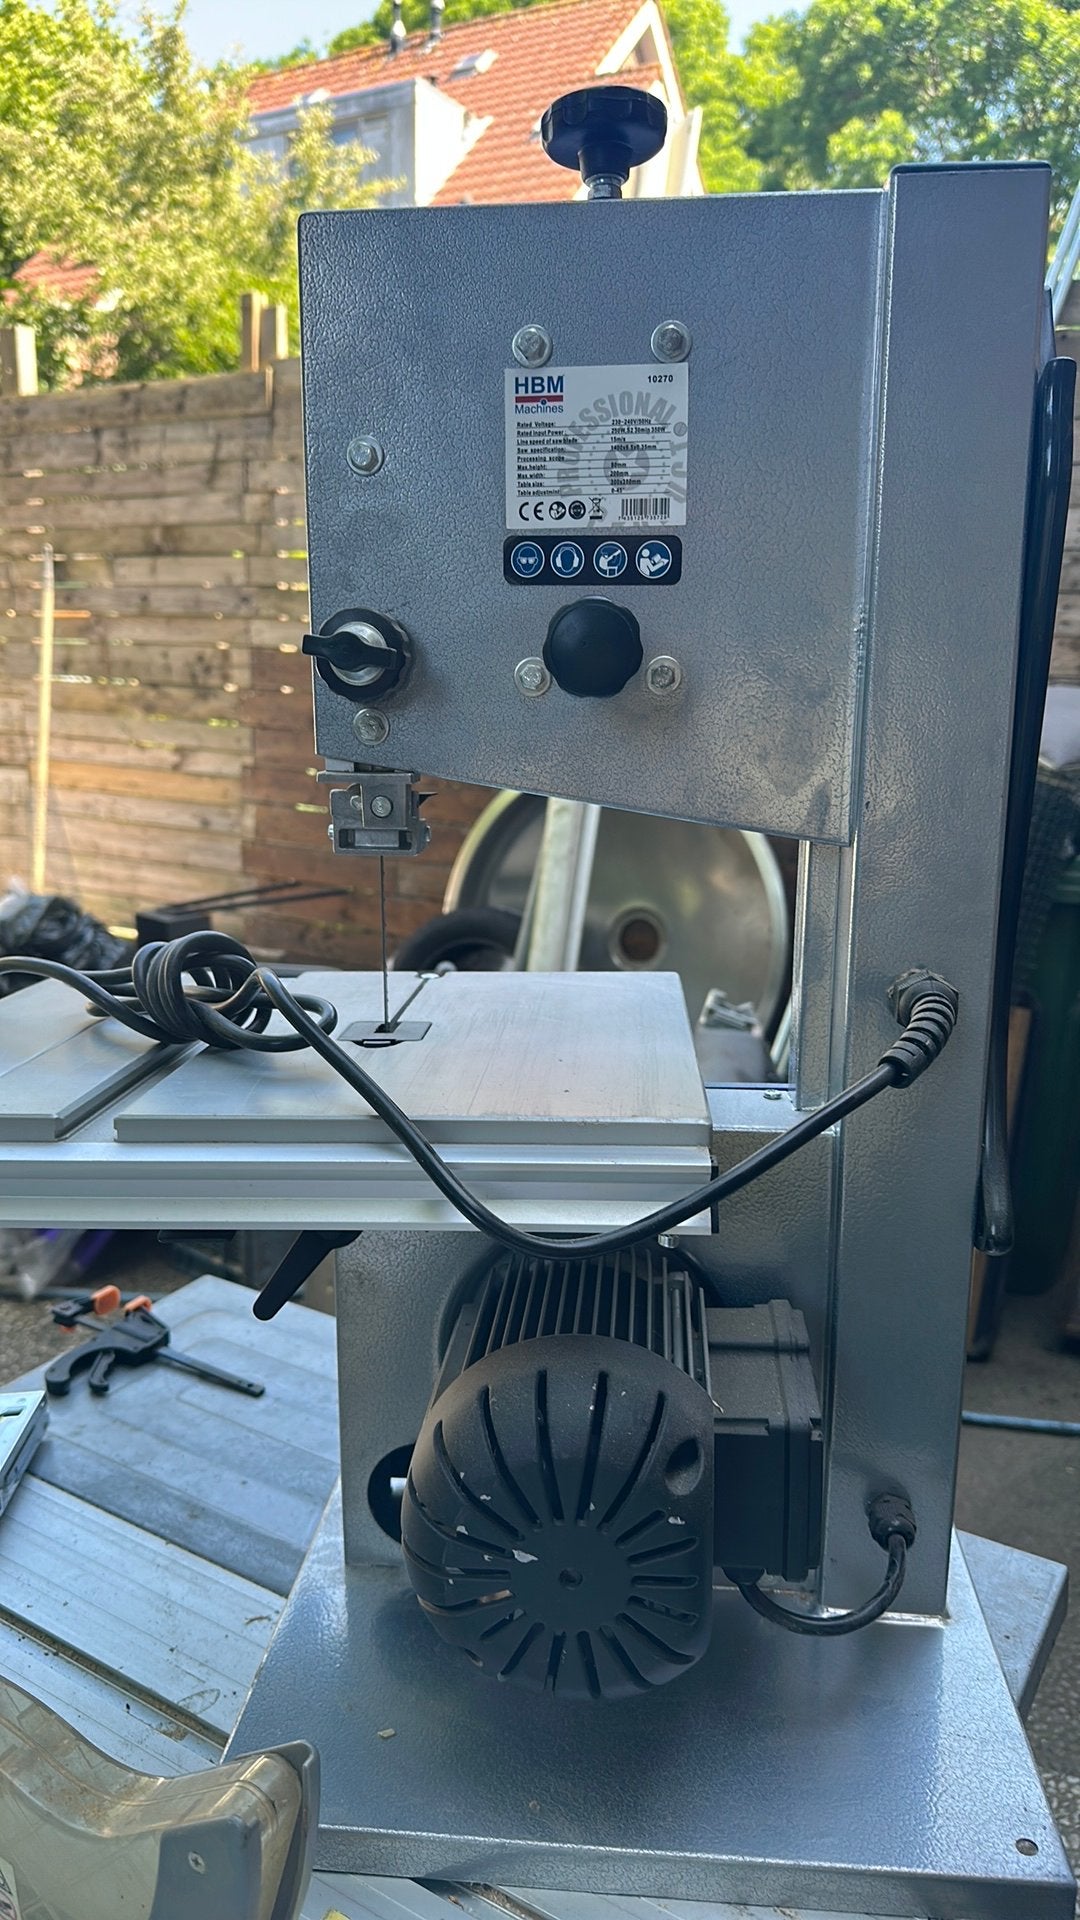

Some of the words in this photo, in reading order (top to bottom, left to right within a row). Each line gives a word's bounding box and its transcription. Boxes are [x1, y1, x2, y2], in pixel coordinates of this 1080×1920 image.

[647, 374, 674, 383] 10270
[514, 376, 564, 394] HBM
[514, 404, 564, 414] Machines
[533, 429, 547, 437] Input
[529, 438, 545, 446] speed
